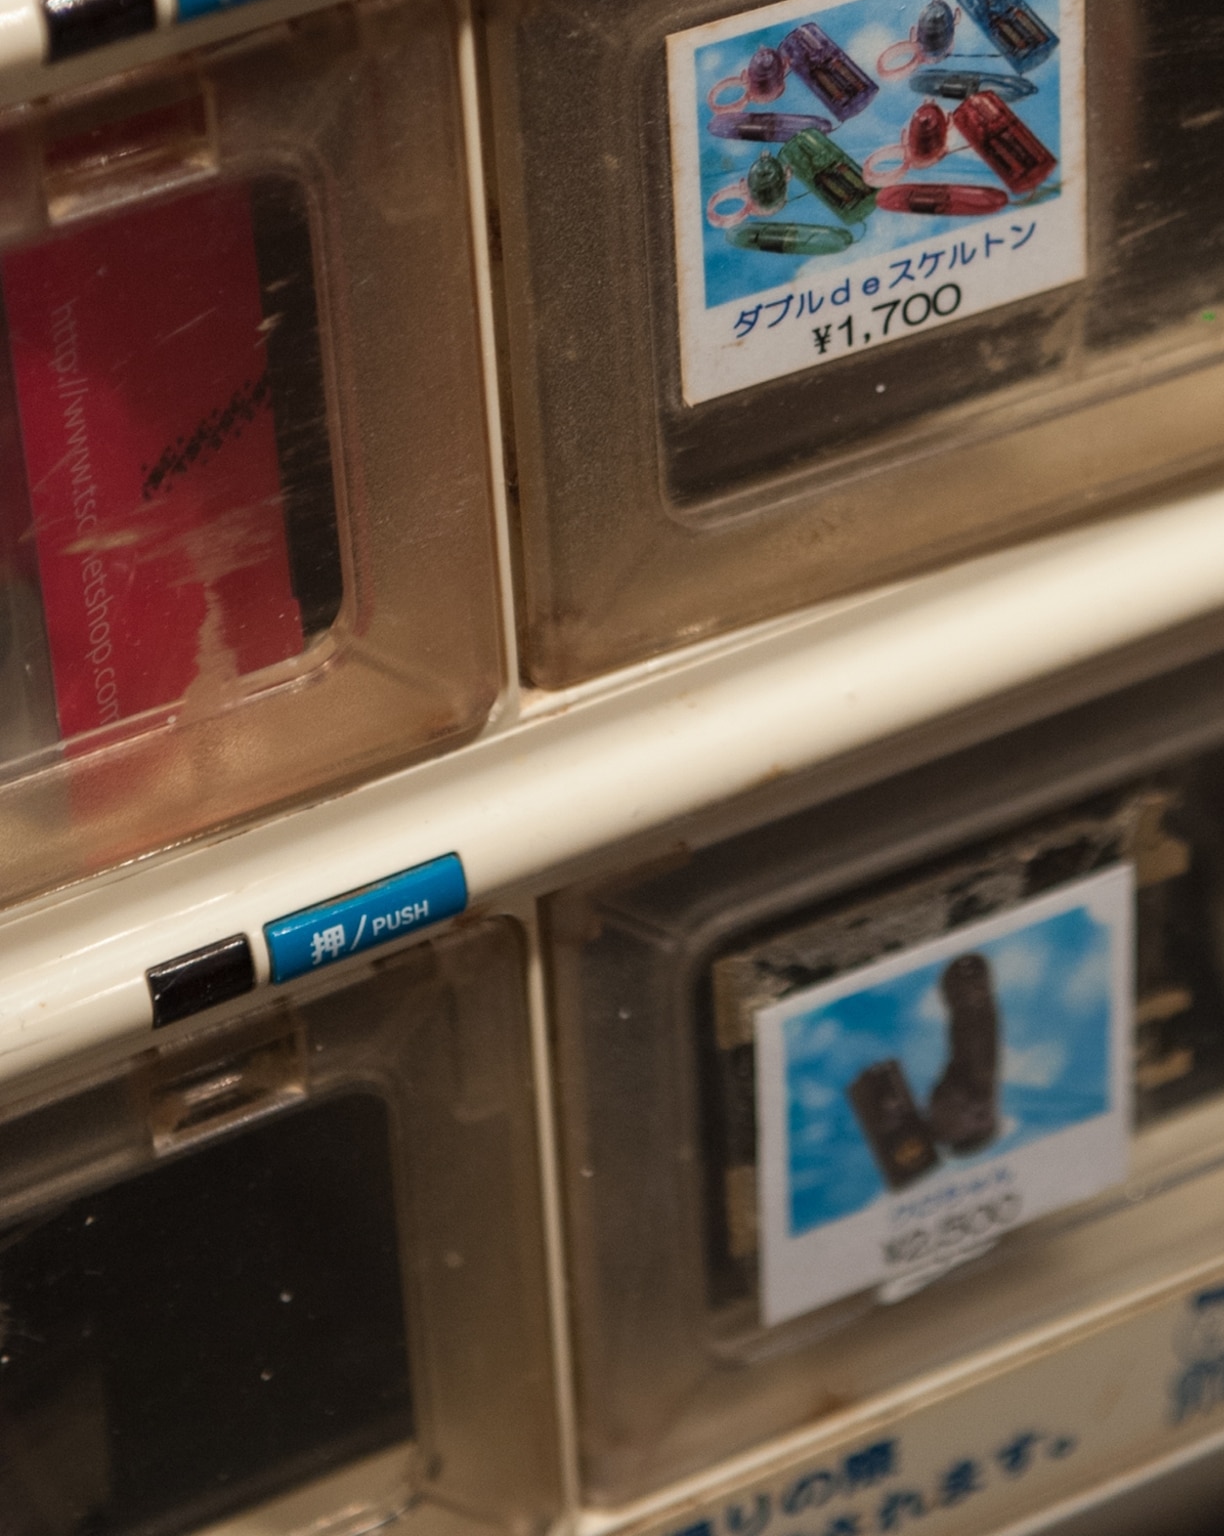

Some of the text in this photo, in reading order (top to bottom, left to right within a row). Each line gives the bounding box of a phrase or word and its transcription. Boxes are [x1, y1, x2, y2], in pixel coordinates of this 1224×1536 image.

[733, 221, 1037, 339] ダブルdeスケルトン
[812, 282, 963, 355] ¥1,700
